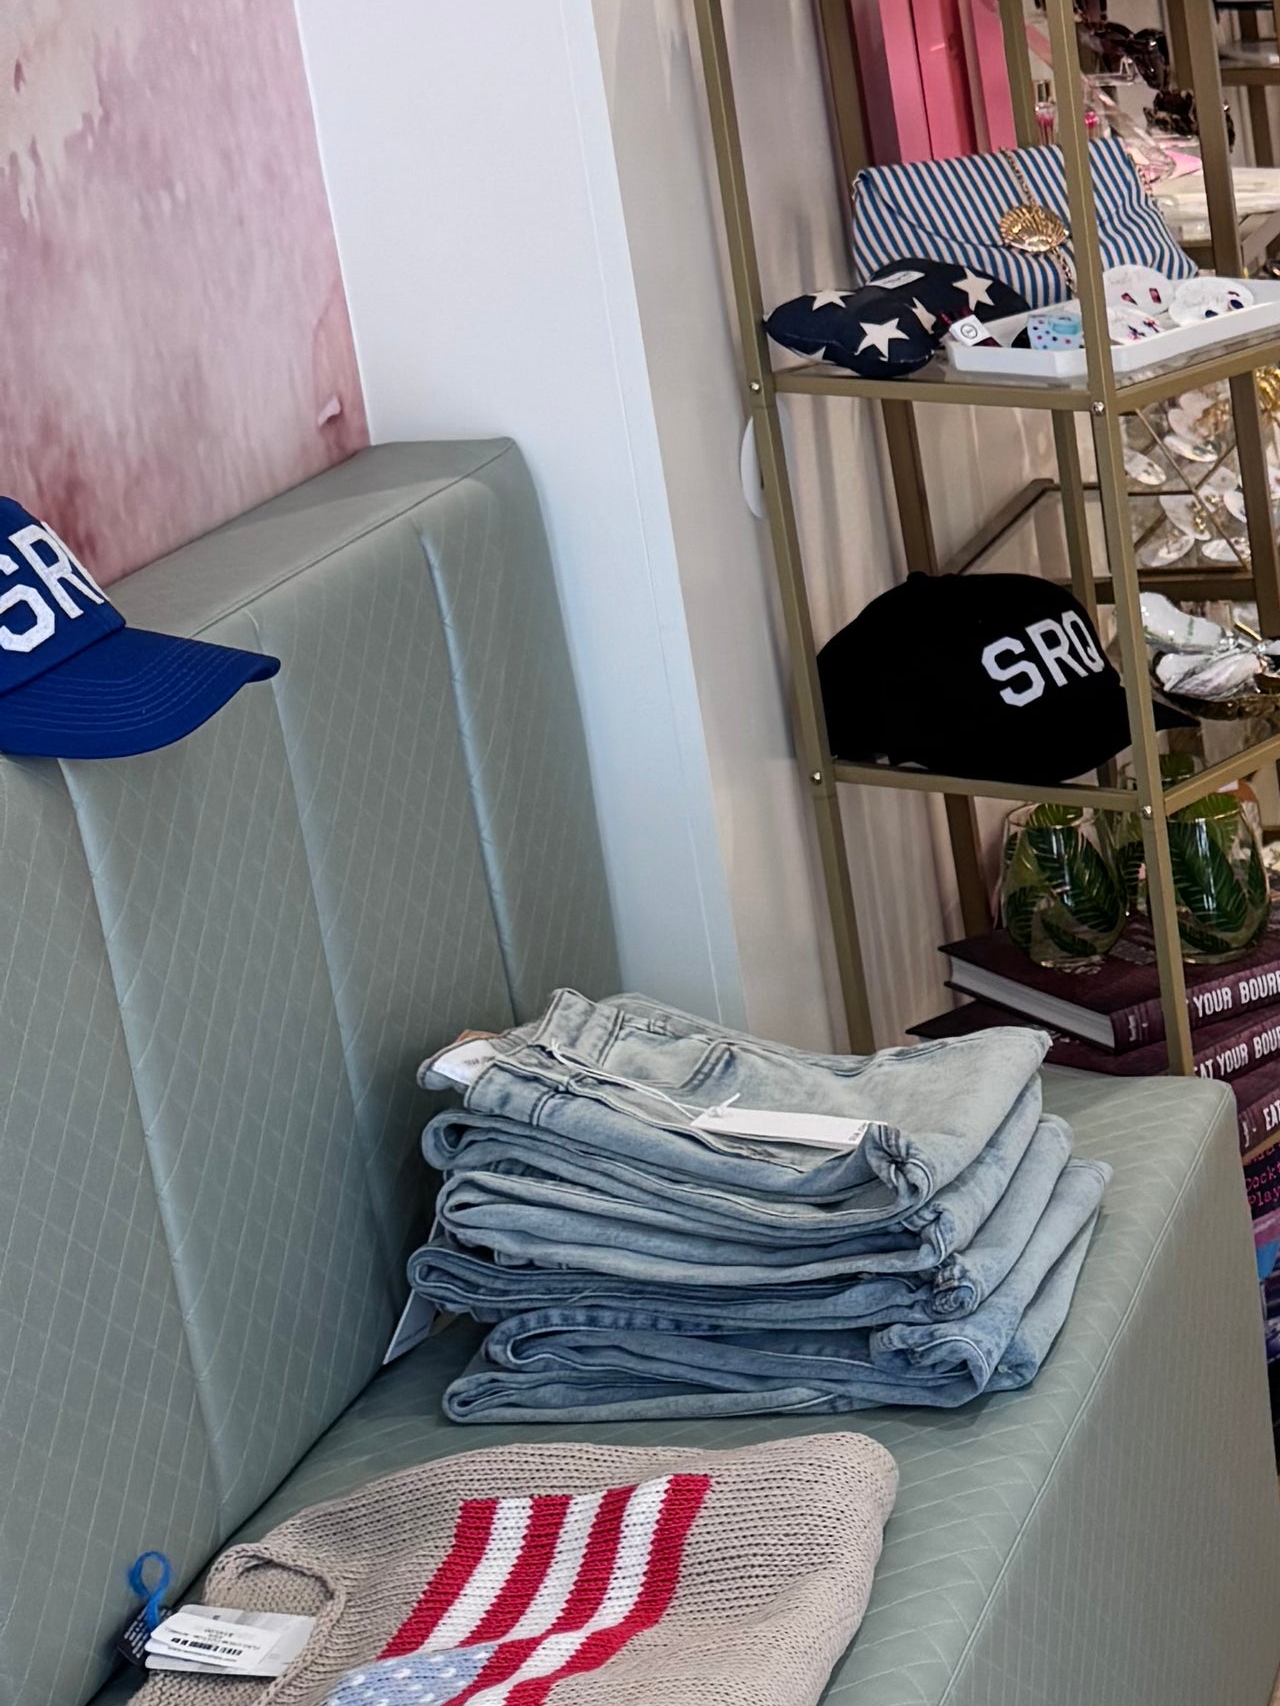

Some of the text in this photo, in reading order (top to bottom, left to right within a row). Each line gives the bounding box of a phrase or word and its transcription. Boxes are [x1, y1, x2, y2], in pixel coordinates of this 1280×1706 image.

[0, 521, 110, 653] SR
[981, 610, 1106, 707] SRQ
[1193, 988, 1233, 1019] YOUR
[1216, 1046, 1249, 1075] YOUR
